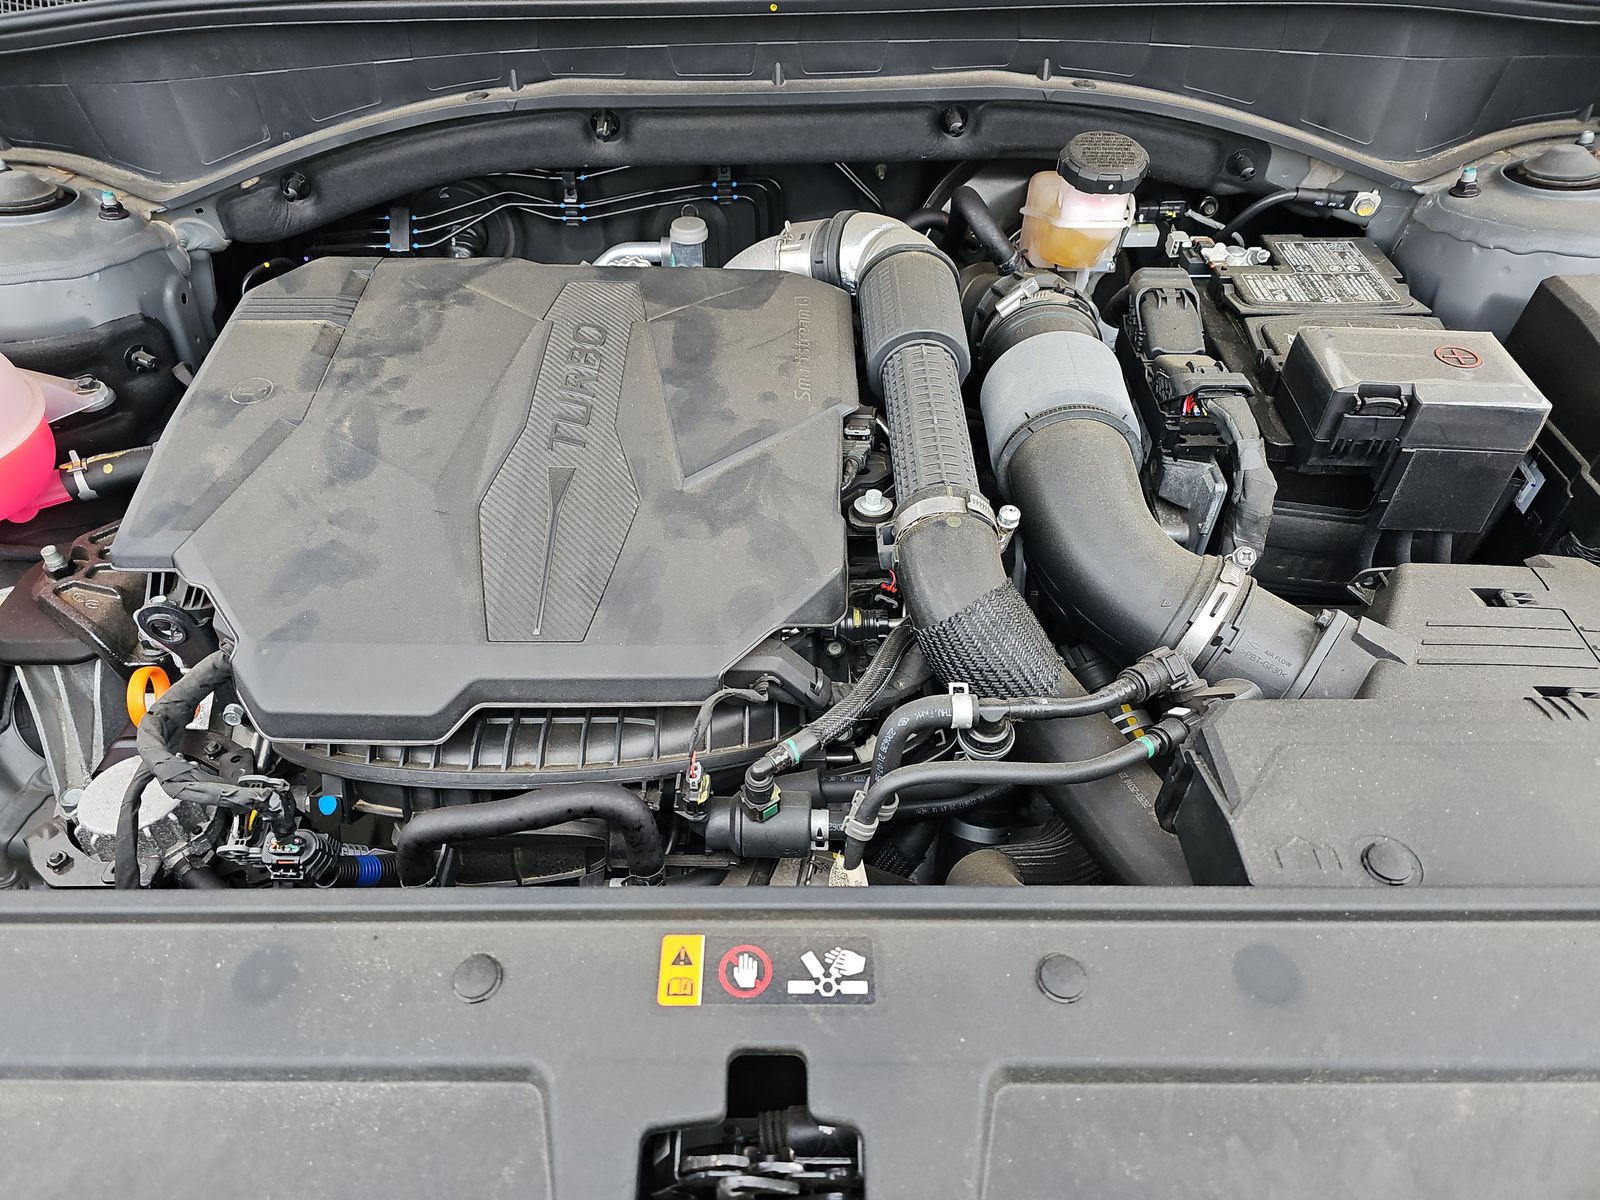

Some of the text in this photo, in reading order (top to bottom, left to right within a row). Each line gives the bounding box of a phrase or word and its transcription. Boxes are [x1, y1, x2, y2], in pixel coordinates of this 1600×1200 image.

[793, 309, 812, 402] Smartstream
[547, 323, 608, 453] TURBO
[1239, 648, 1289, 679] >PBT-GF30<
[1264, 650, 1293, 668] AIR FLOW
